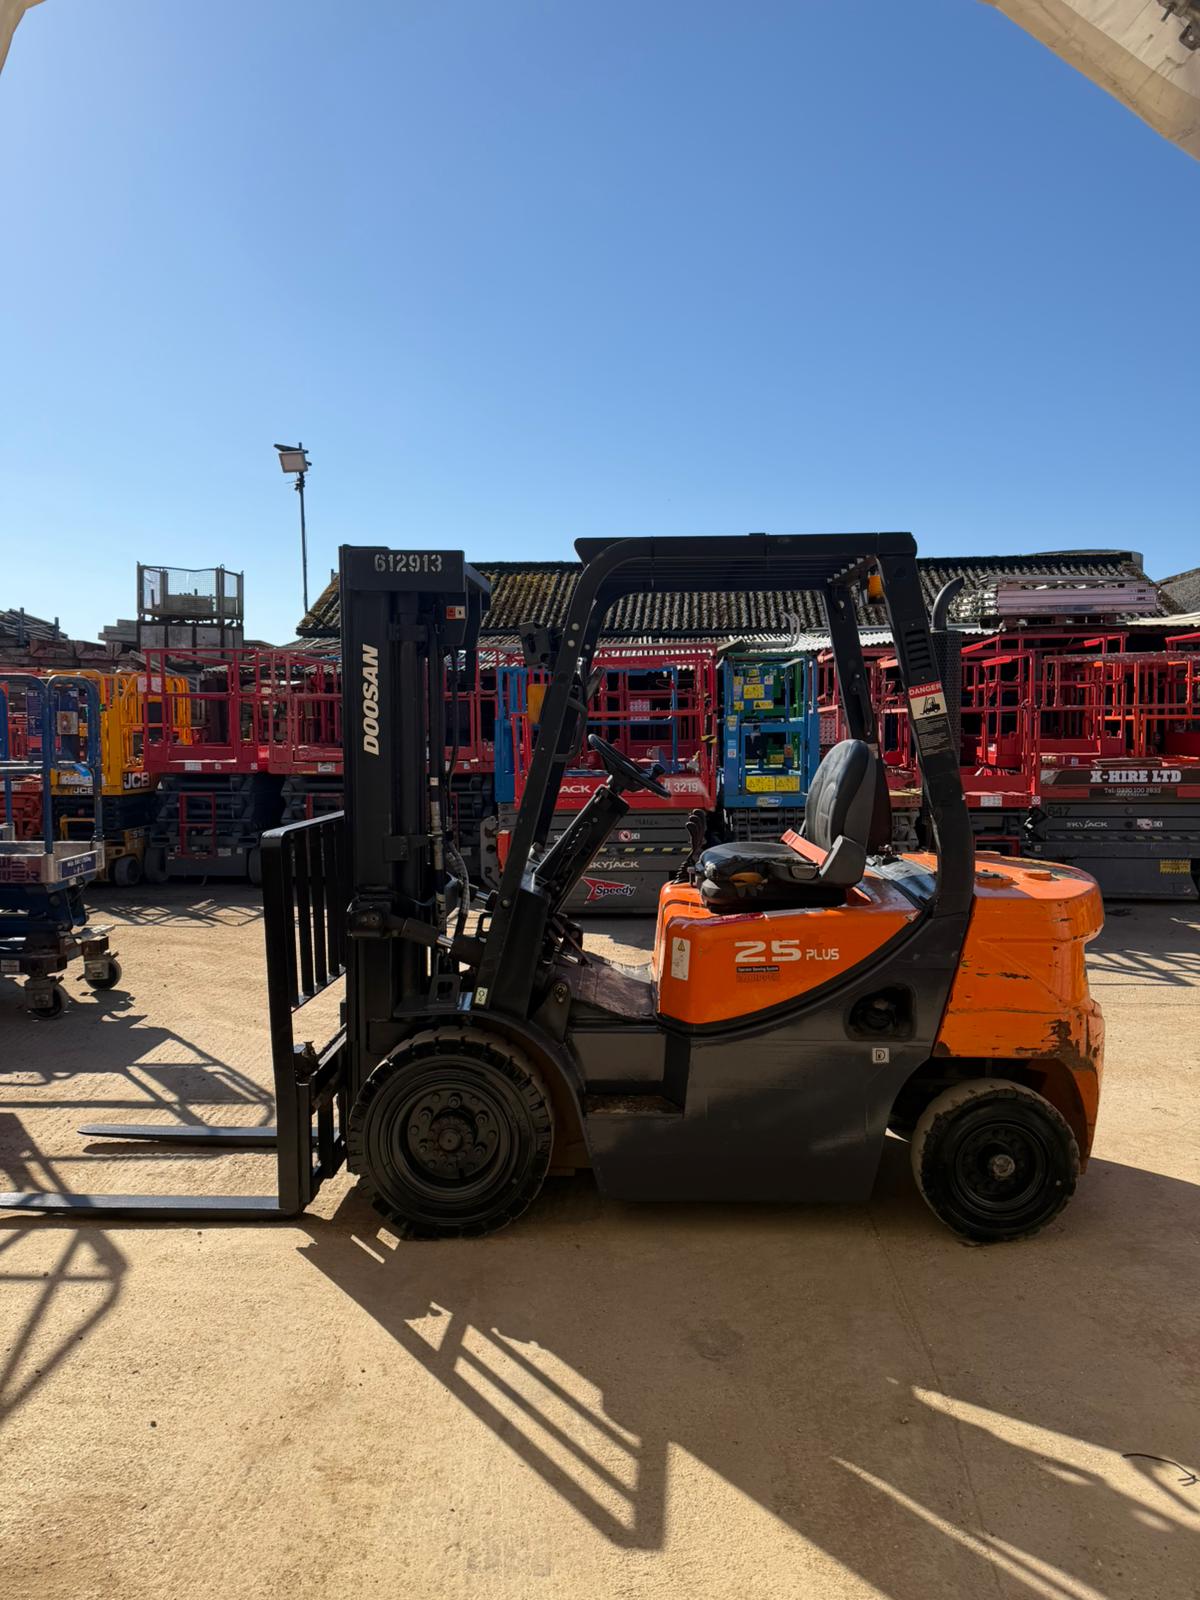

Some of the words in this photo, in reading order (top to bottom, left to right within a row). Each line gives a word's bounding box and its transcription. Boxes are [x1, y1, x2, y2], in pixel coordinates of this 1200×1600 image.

[374, 554, 443, 572] 612913
[908, 682, 942, 696] DANGER
[362, 643, 380, 756] DOOSAN
[123, 771, 150, 790] JCB
[1151, 770, 1182, 783] LTD
[673, 782, 698, 793] 3219
[1066, 819, 1108, 829] SKYJACK
[595, 885, 636, 896] Speedy
[735, 940, 802, 963] 25
[806, 948, 839, 960] PLUS
